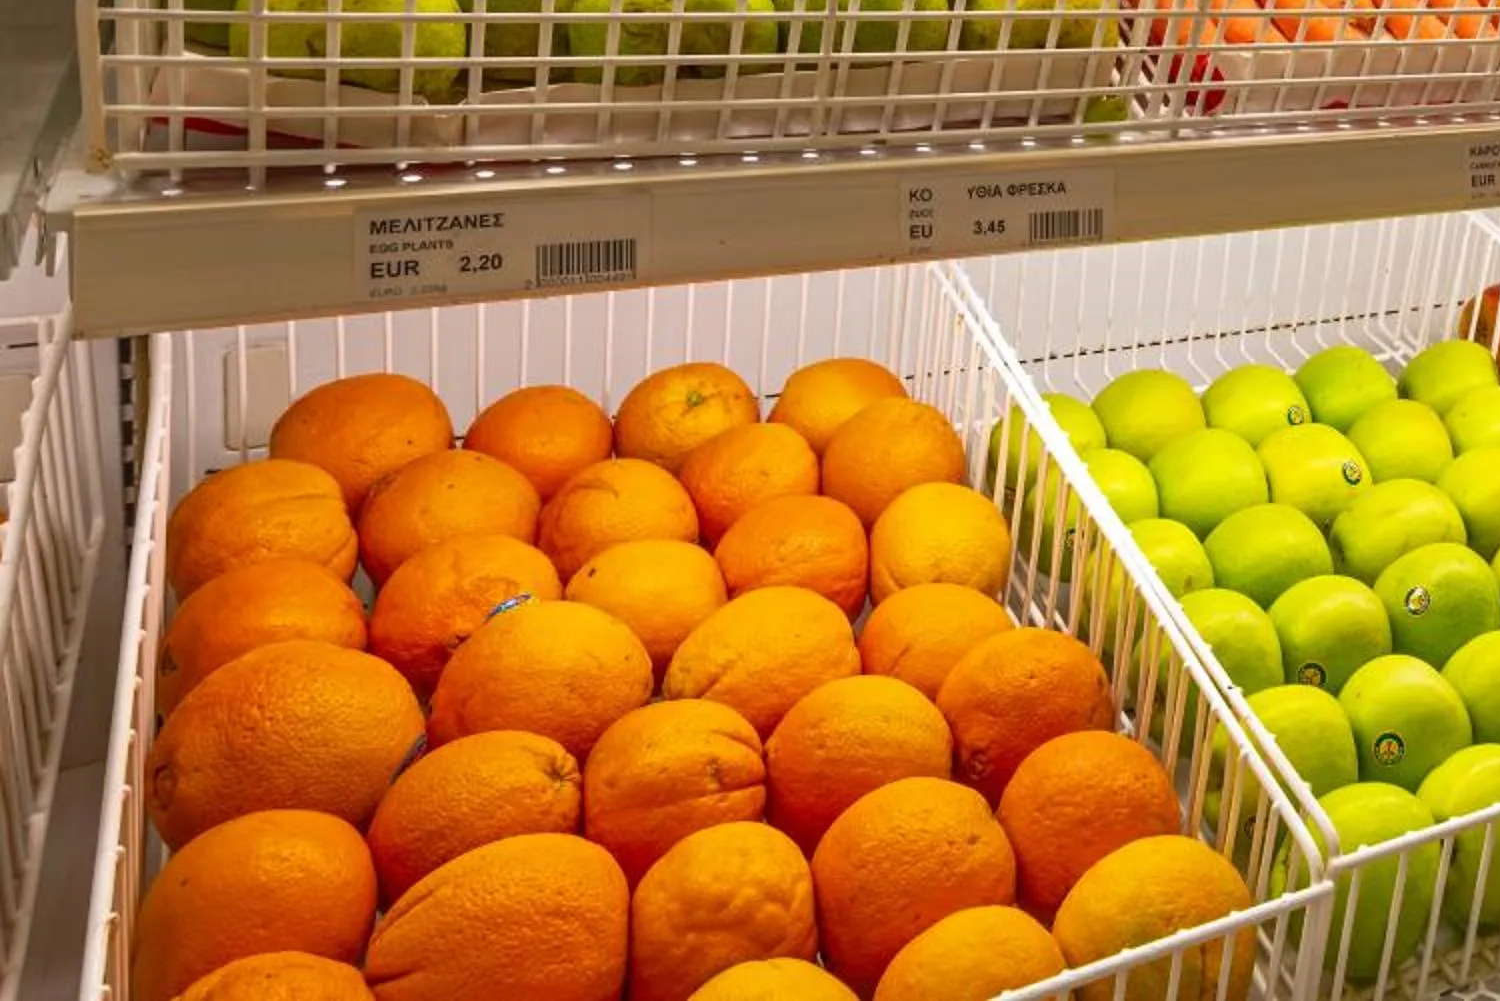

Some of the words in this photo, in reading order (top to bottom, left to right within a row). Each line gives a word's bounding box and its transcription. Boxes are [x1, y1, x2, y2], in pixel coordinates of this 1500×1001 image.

[1006, 180, 1067, 197] ΦΡΕΣΚΑ
[1471, 174, 1496, 188] EUR
[369, 212, 505, 236] ΜΕΛΙΤΖΑΝΕΣ
[909, 224, 934, 240] EU
[370, 260, 419, 279] EUR
[460, 253, 503, 274] 2,20
